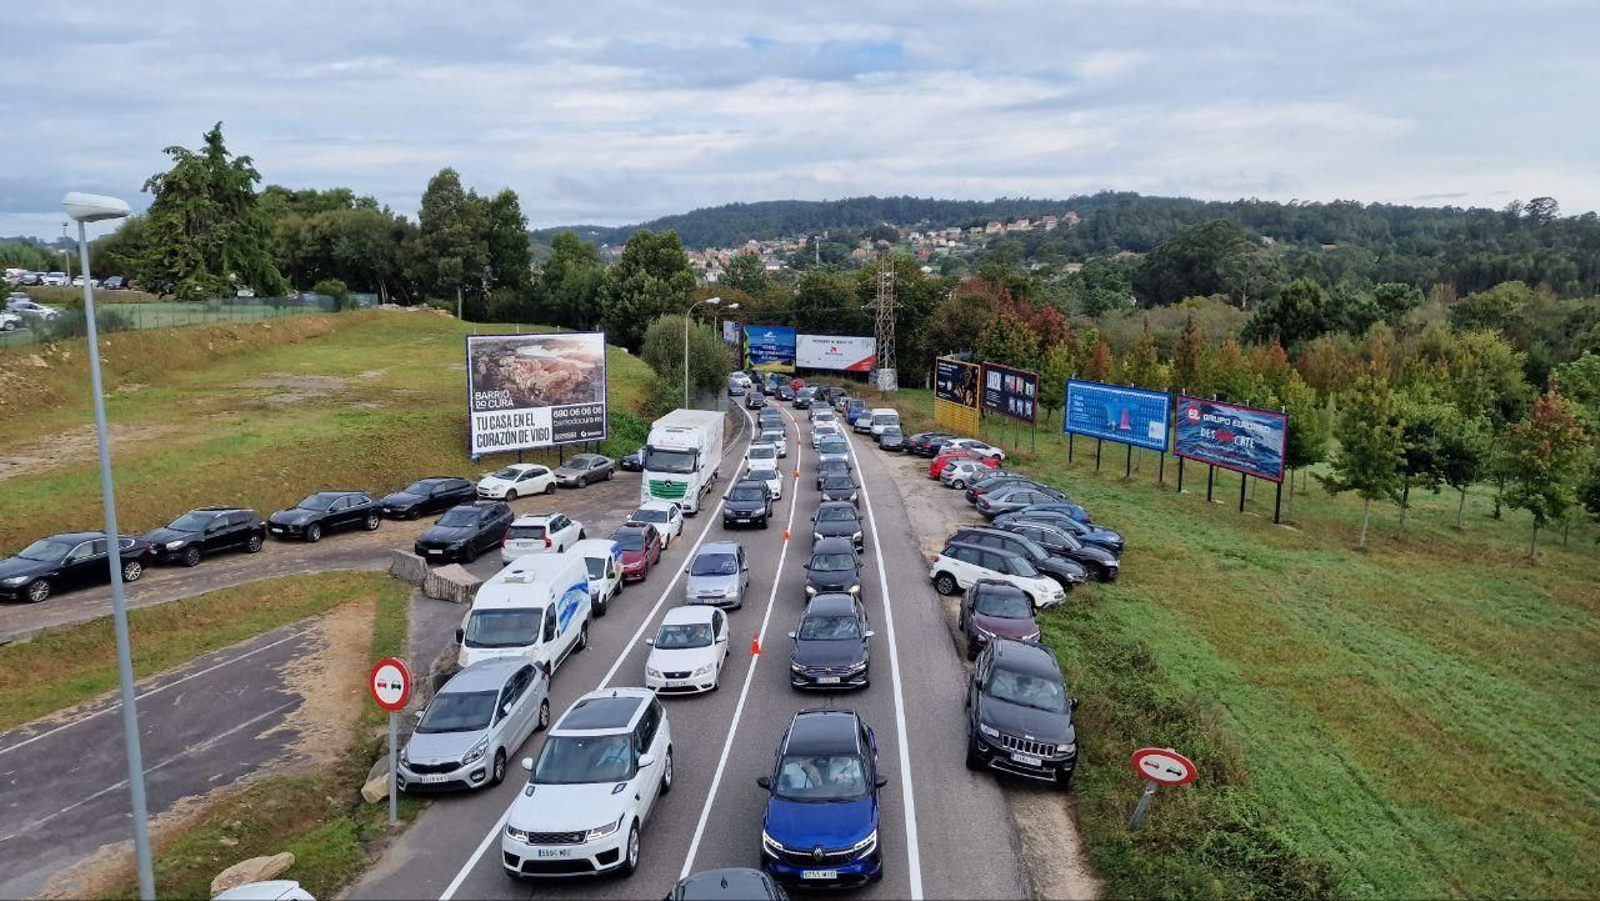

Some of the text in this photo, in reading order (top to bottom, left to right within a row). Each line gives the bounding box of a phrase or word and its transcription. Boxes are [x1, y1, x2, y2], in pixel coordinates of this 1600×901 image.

[475, 390, 510, 400] BARRIO
[475, 399, 514, 409] DO CURA
[553, 409, 568, 418] 690
[476, 412, 535, 431] TU CASA EN EL
[1203, 414, 1231, 426] GRUPO
[477, 430, 517, 448] CORAZÓN
[519, 429, 529, 444] DE
[530, 427, 550, 442] VIGO
